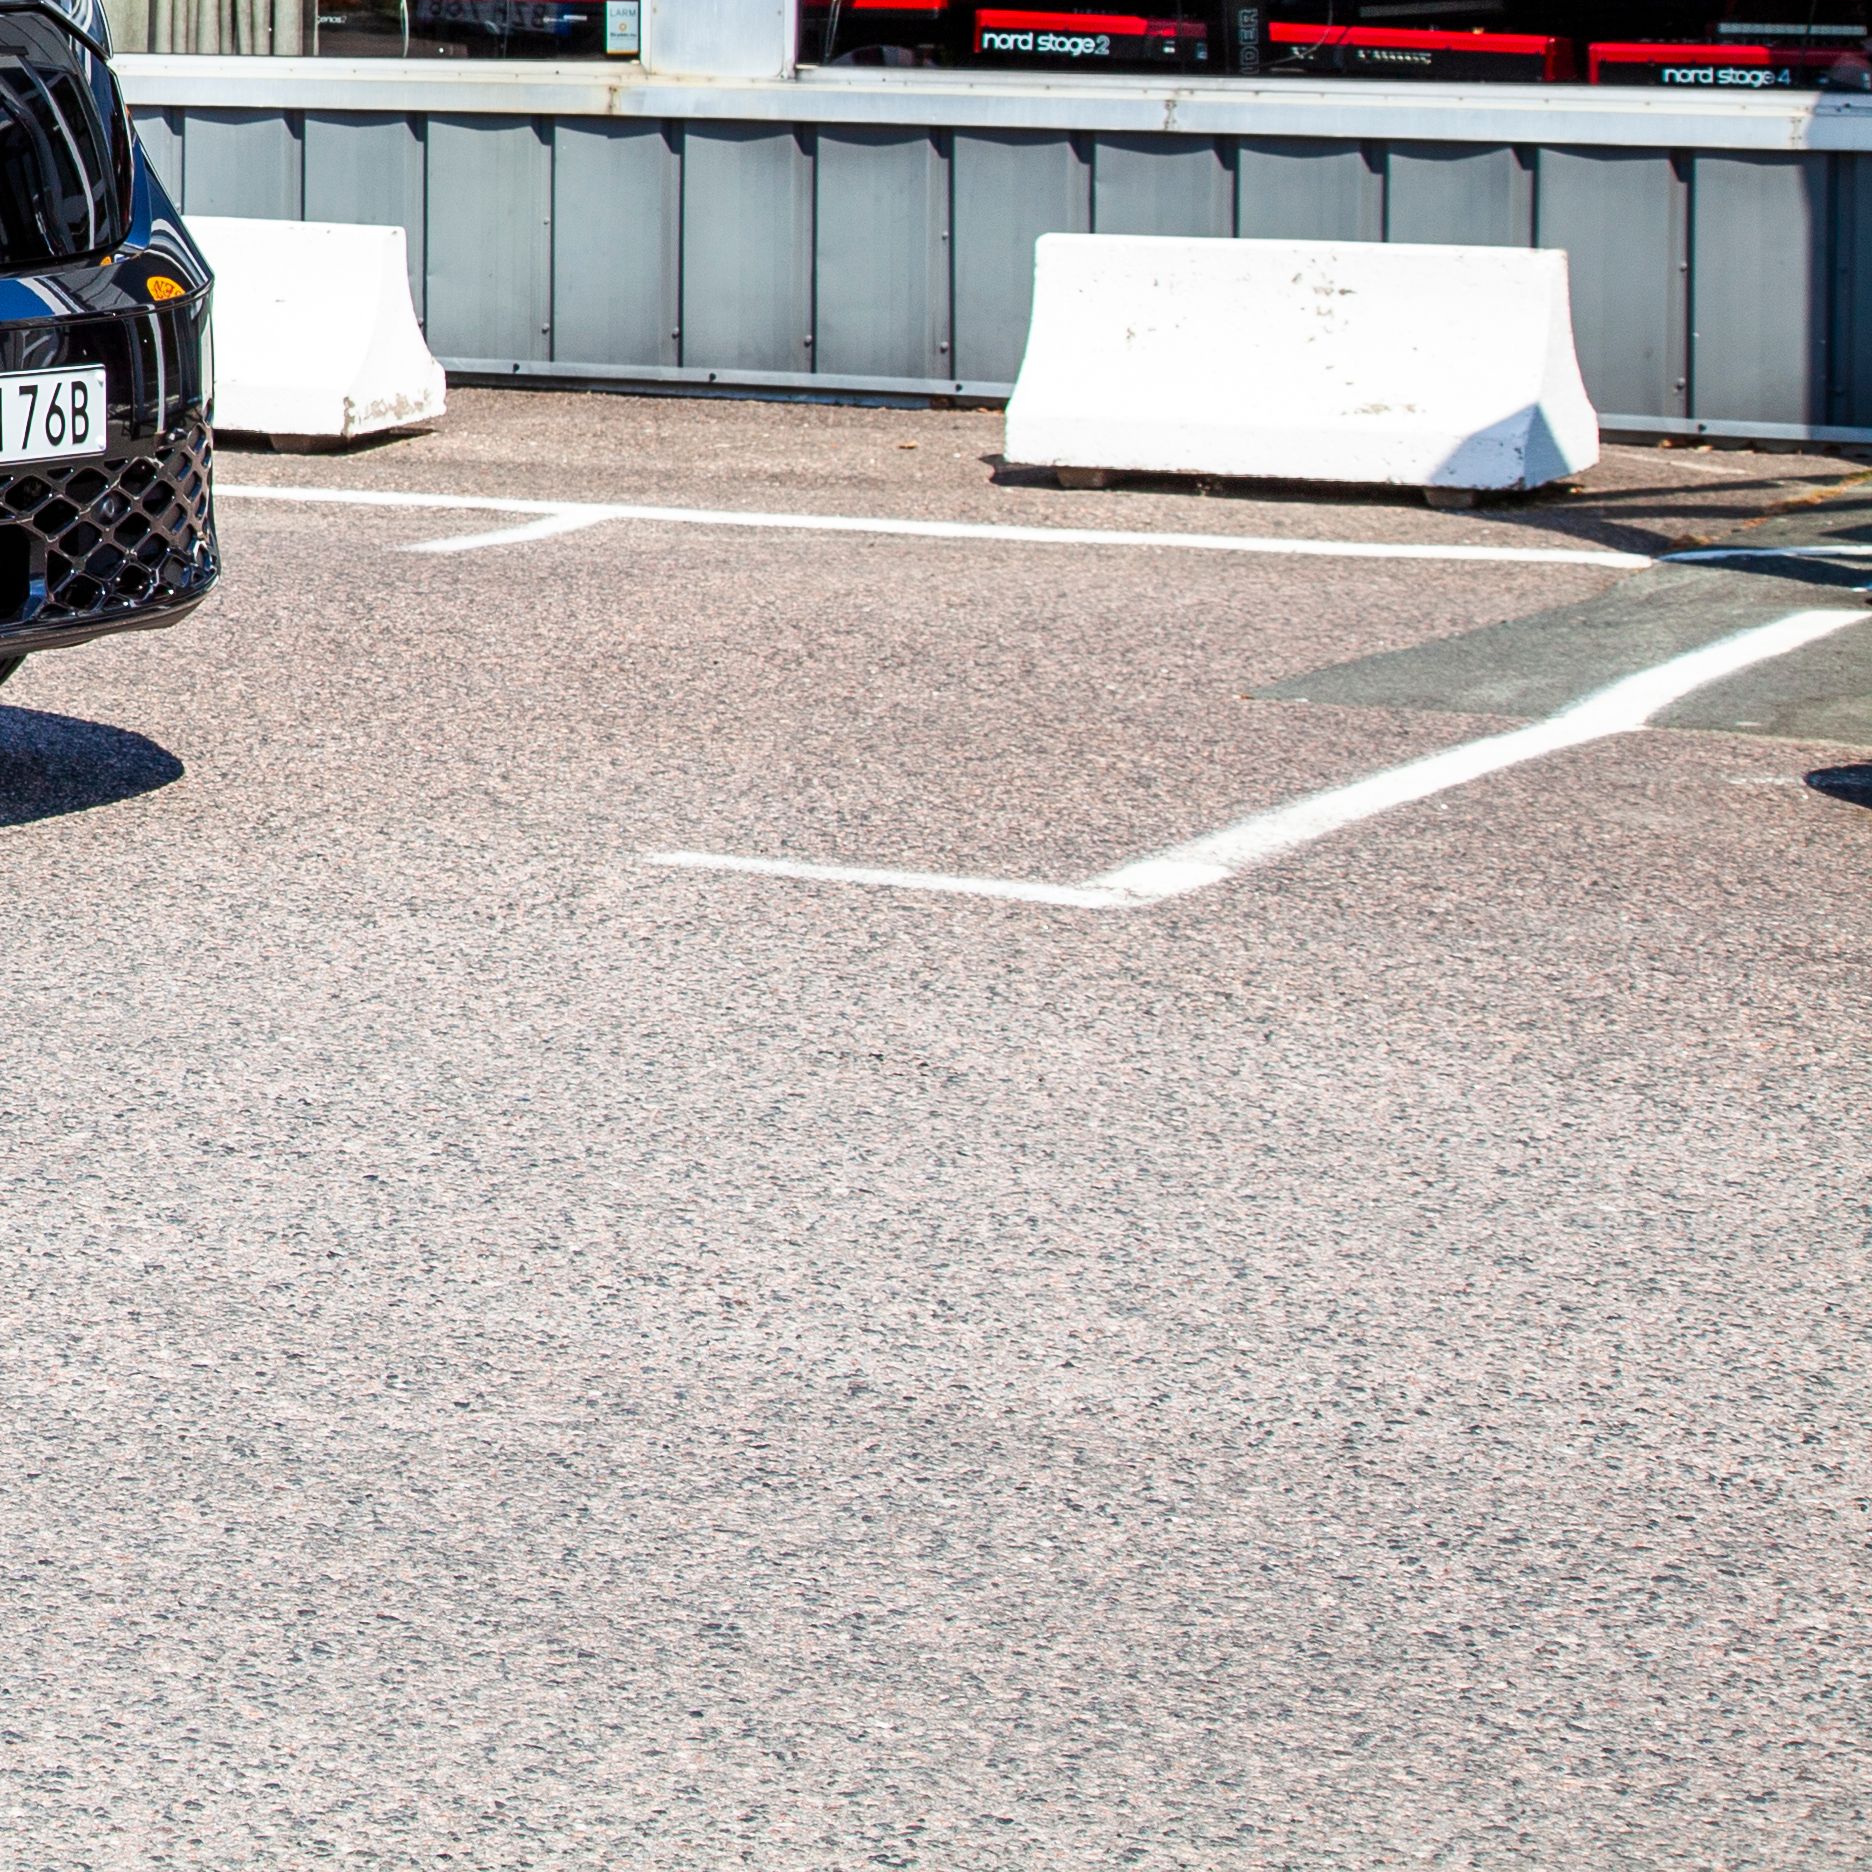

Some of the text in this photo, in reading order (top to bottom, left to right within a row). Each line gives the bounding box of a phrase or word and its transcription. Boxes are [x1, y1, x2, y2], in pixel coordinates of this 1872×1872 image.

[982, 32, 1034, 52] nord
[1662, 66, 1714, 85] nord
[18, 380, 90, 451] 76B
